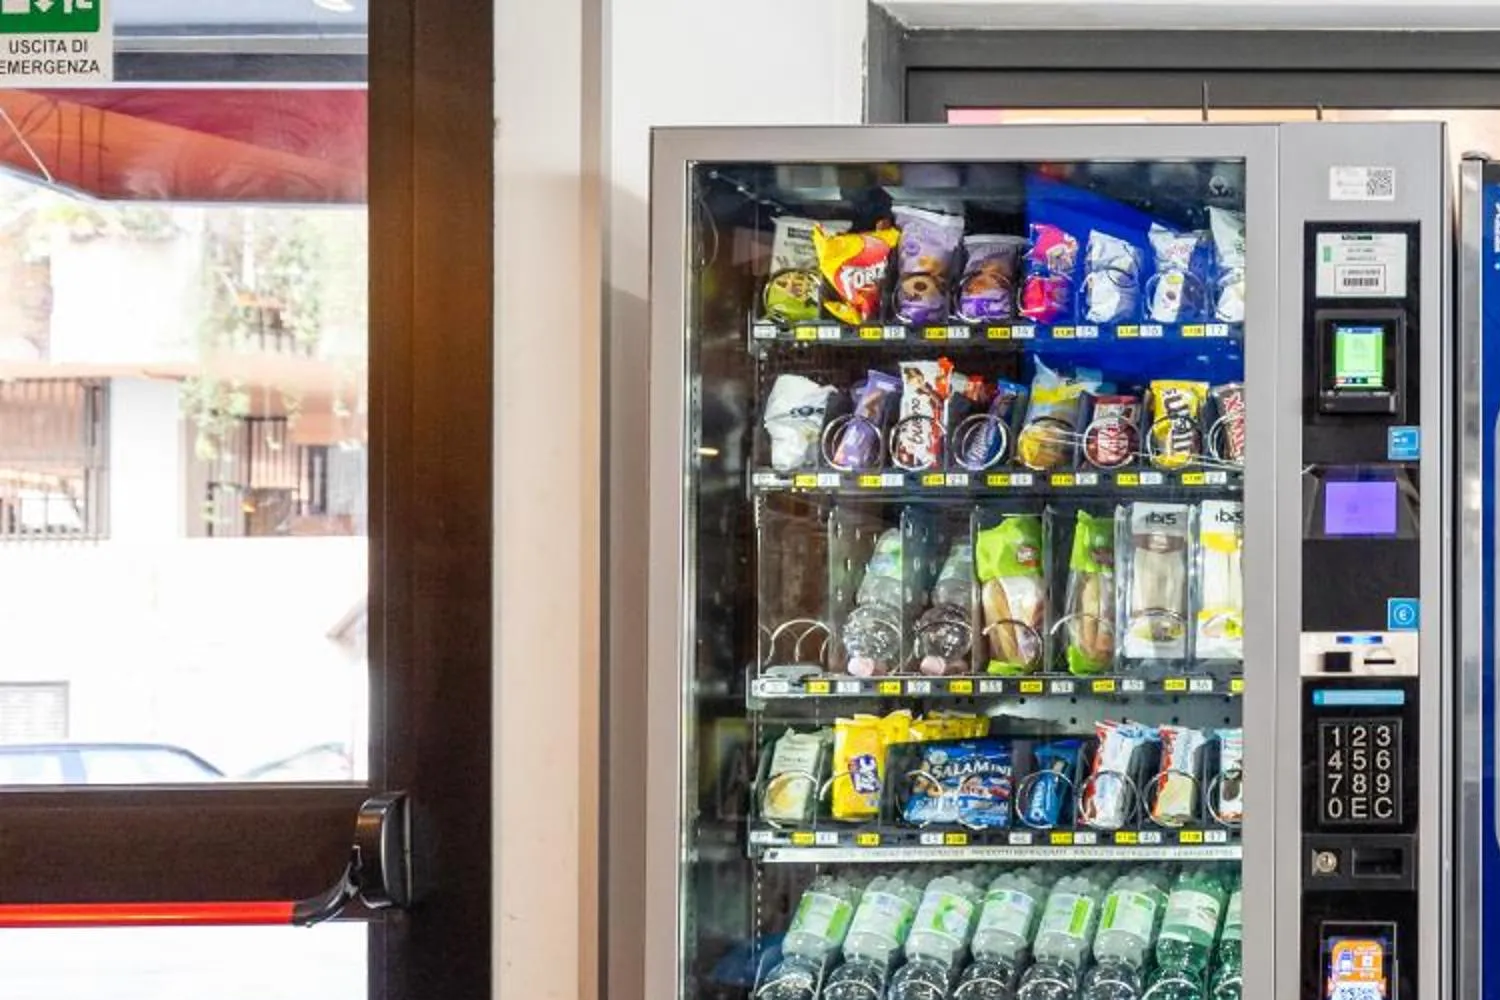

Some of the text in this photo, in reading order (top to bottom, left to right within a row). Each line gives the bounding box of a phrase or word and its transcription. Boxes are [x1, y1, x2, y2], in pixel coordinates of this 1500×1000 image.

[9, 39, 88, 54] USCITA DI
[1332, 727, 1390, 746] 1 2 3
[932, 760, 1012, 778] SALAMINI
[1328, 750, 1390, 769] 4 5 6
[1328, 774, 1390, 793] 7 8 9
[1328, 798, 1393, 817] 0 E C
